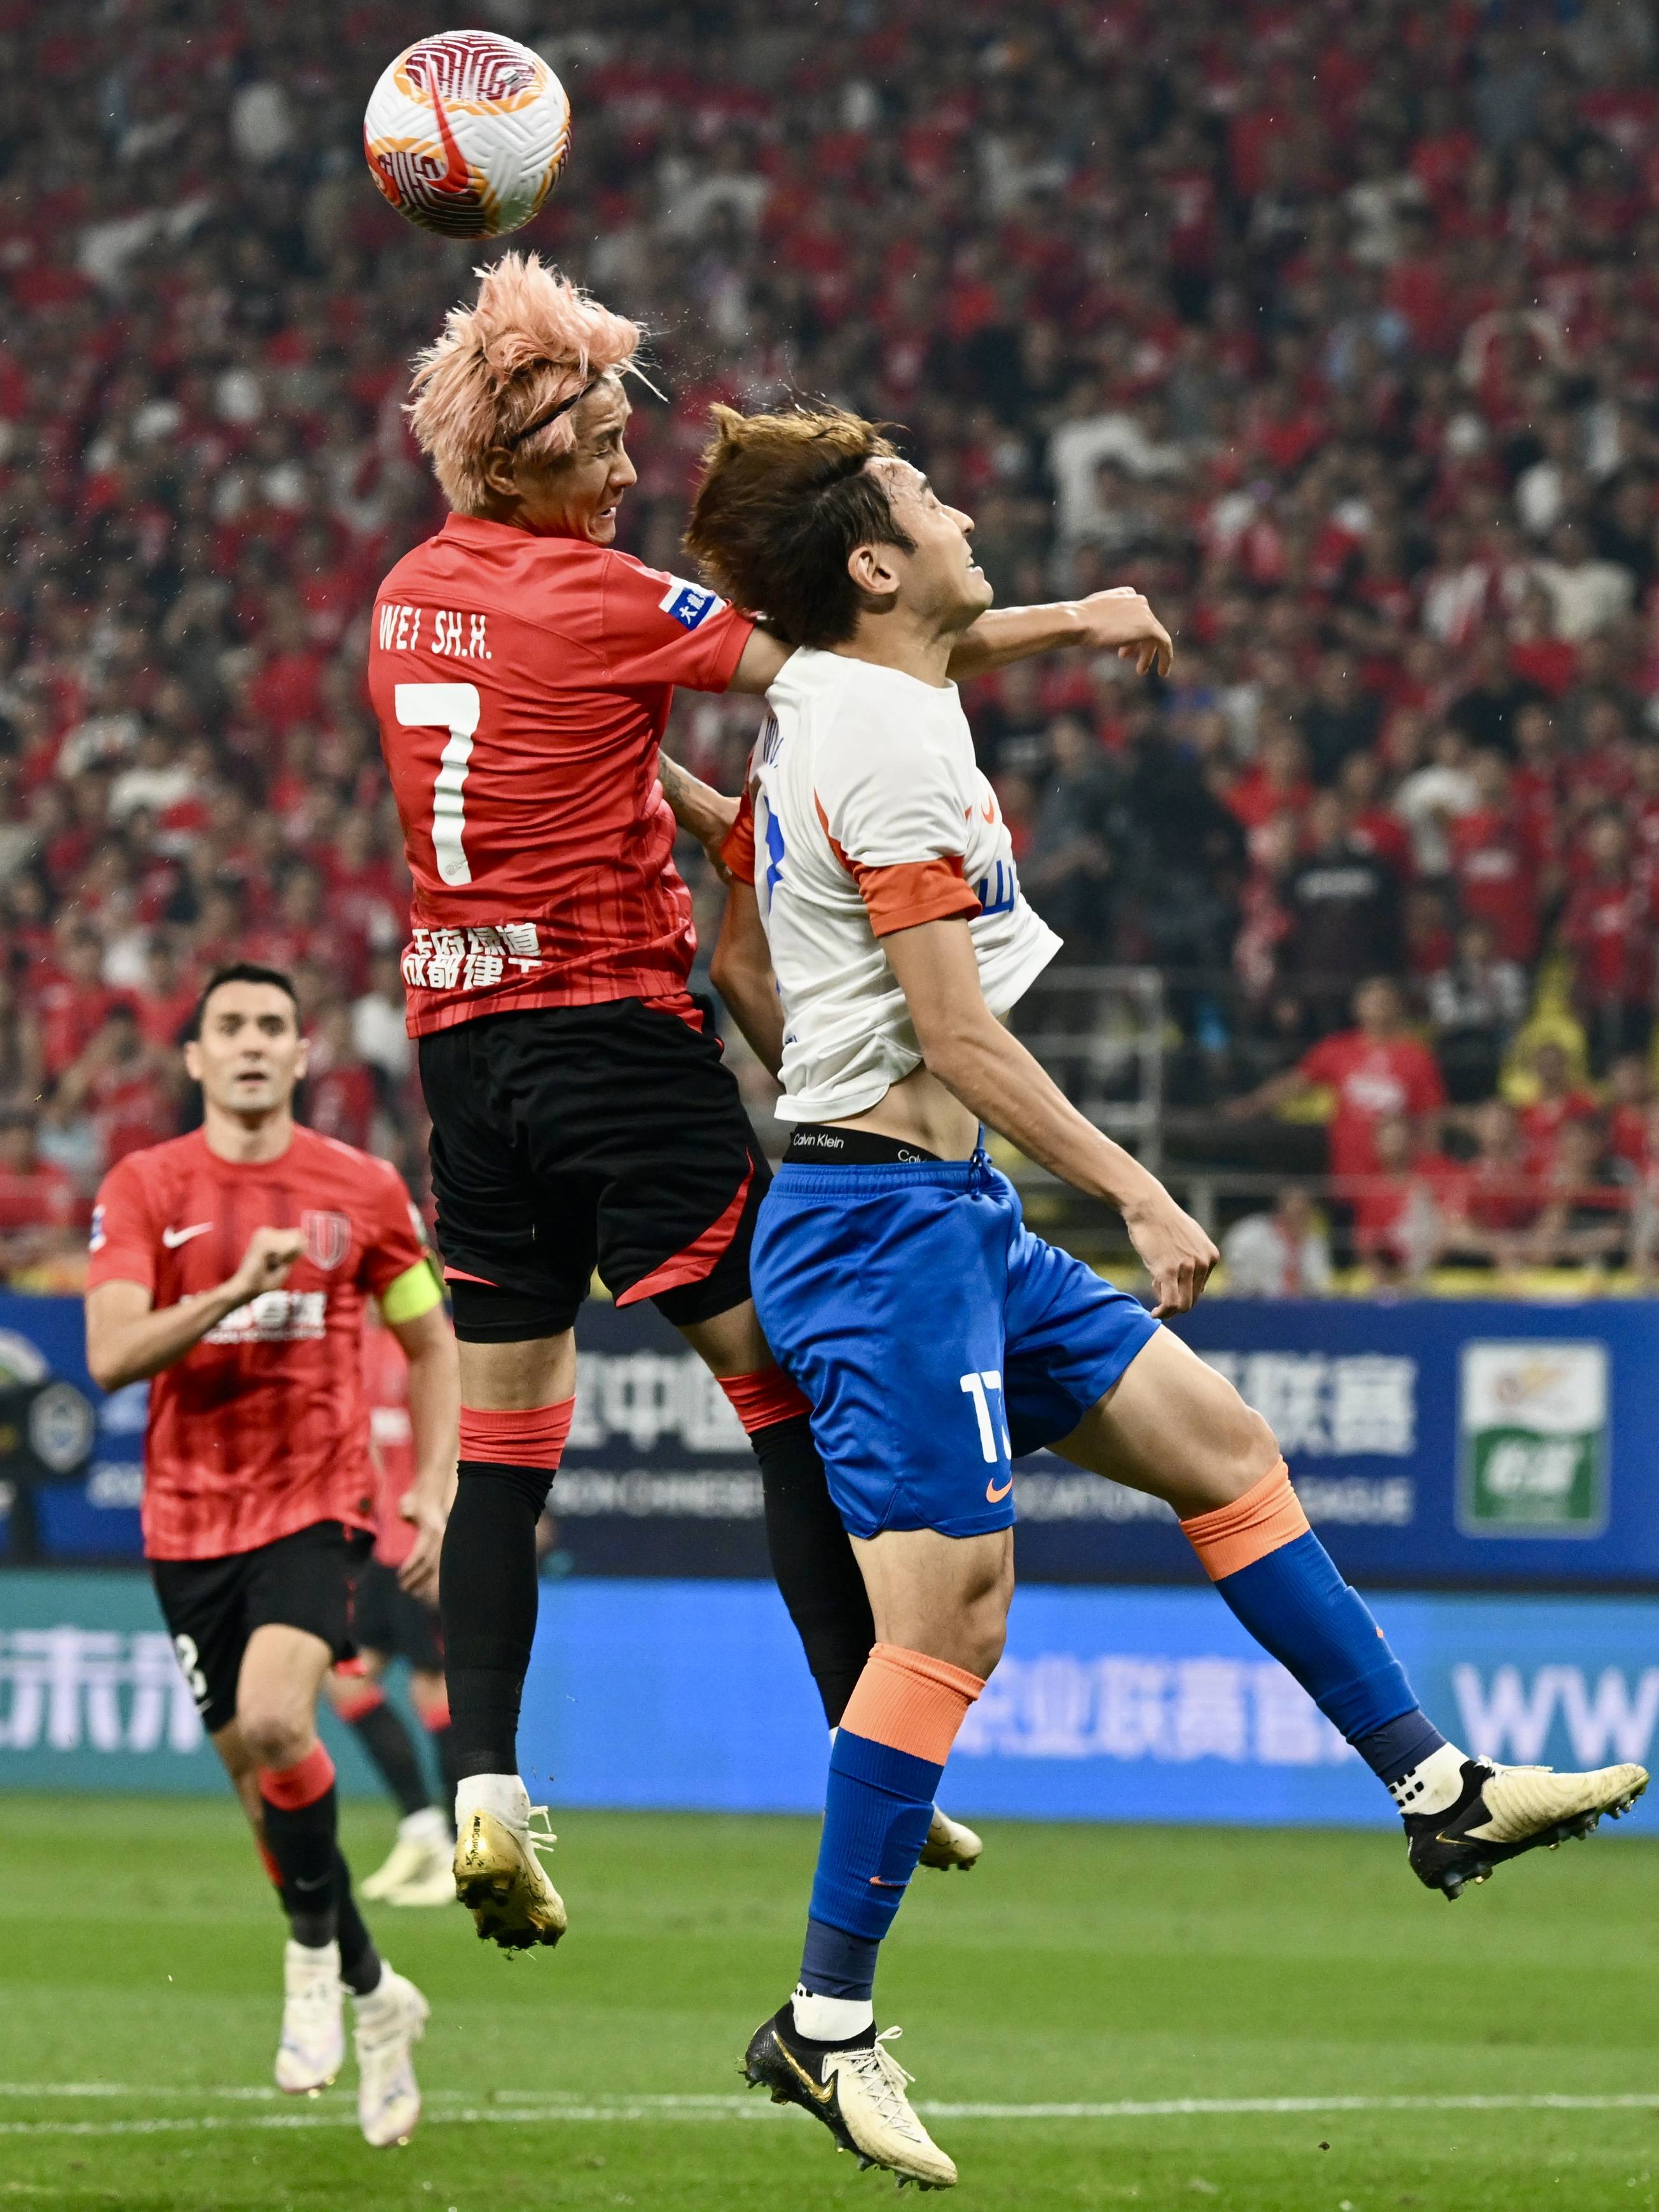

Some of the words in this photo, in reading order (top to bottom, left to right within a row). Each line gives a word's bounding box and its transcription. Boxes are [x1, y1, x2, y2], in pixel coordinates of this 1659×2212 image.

[379, 604, 422, 651] WEI
[431, 610, 492, 659] SH.H.
[394, 682, 481, 886] 7
[793, 1133, 815, 1146] Calvin
[816, 1134, 844, 1149] Klein
